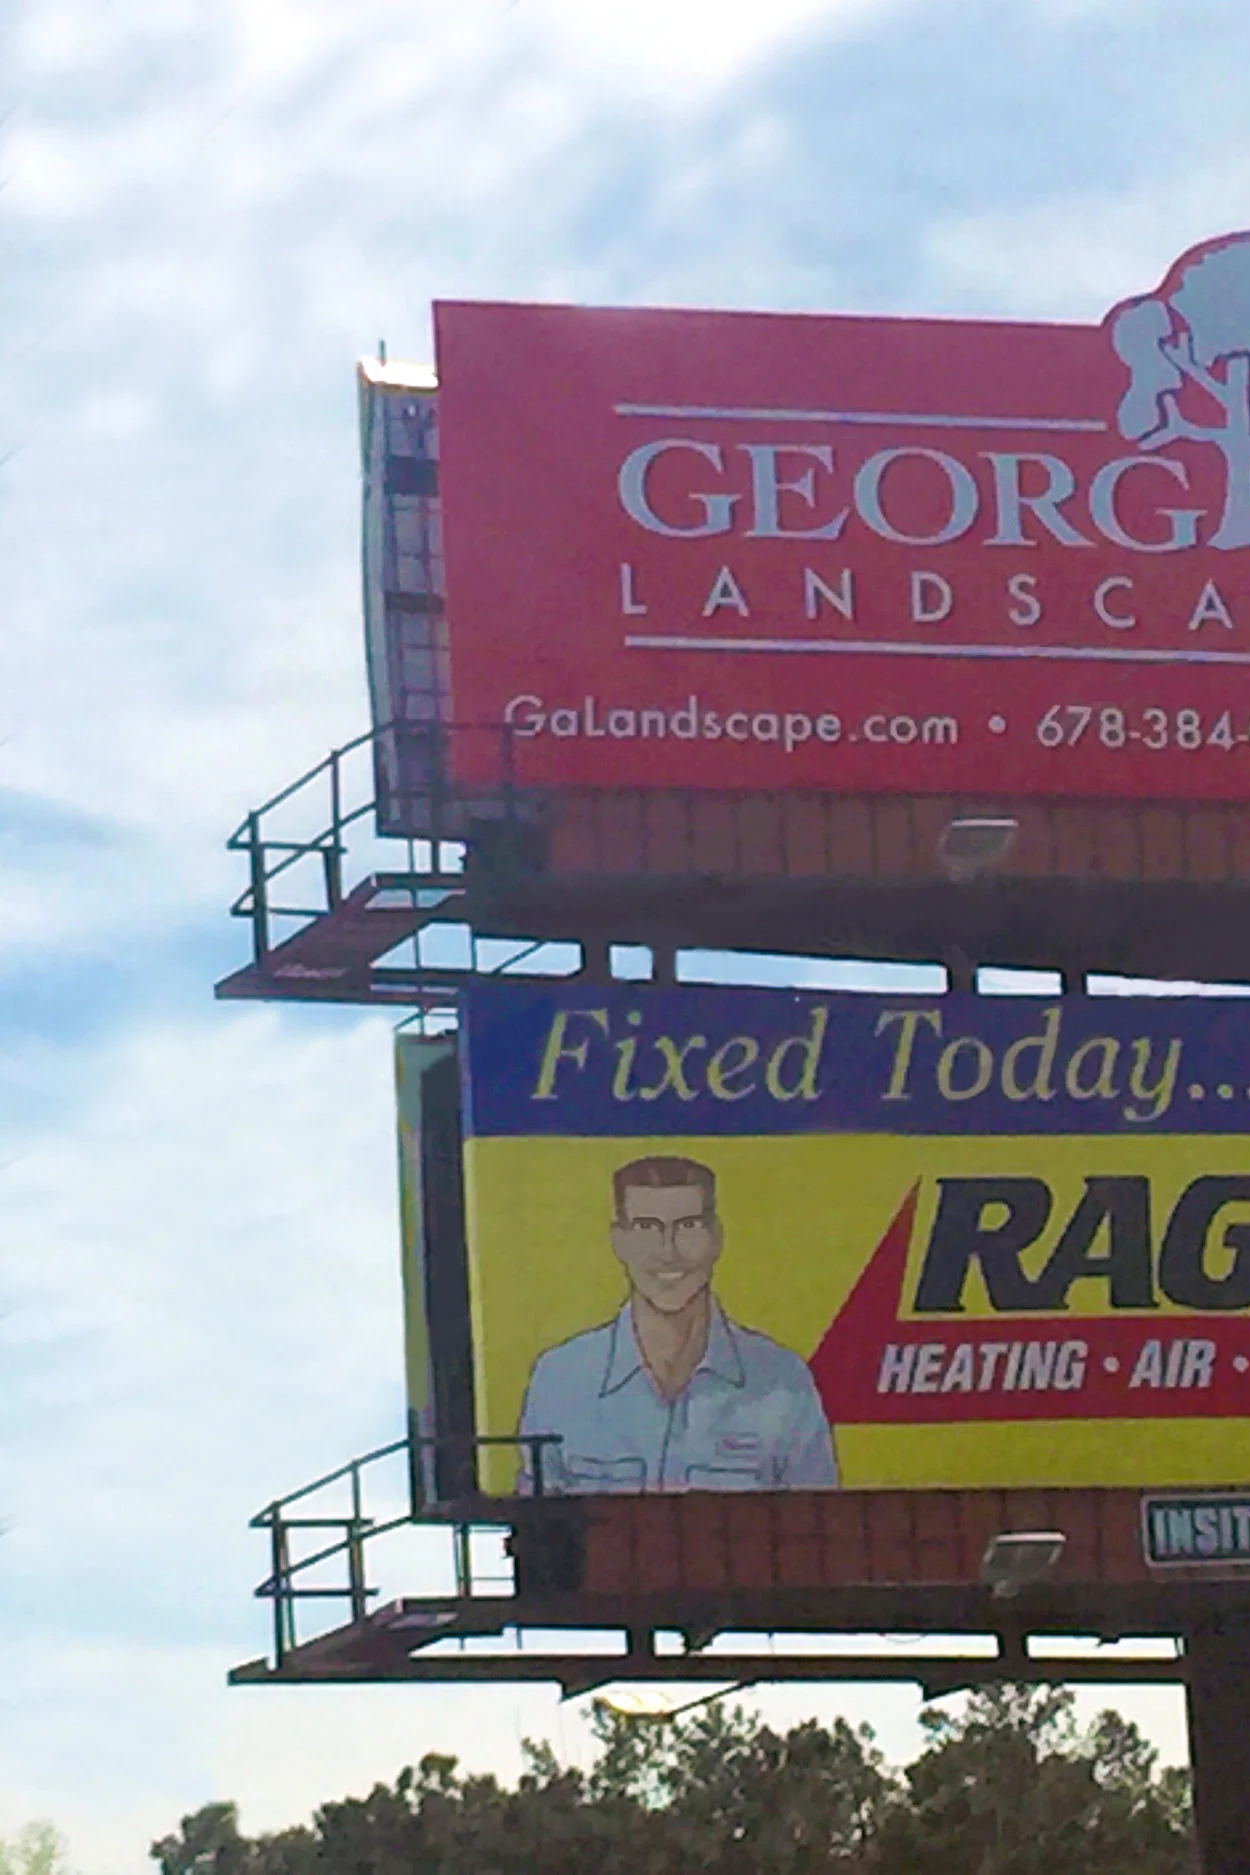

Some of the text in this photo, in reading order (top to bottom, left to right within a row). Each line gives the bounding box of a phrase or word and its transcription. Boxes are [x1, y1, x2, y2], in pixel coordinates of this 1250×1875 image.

[503, 694, 960, 750] GaLandscape.com
[531, 1006, 829, 1102] Fixed
[876, 1342, 1088, 1394] HEATING
[1129, 1340, 1215, 1389] AIR
